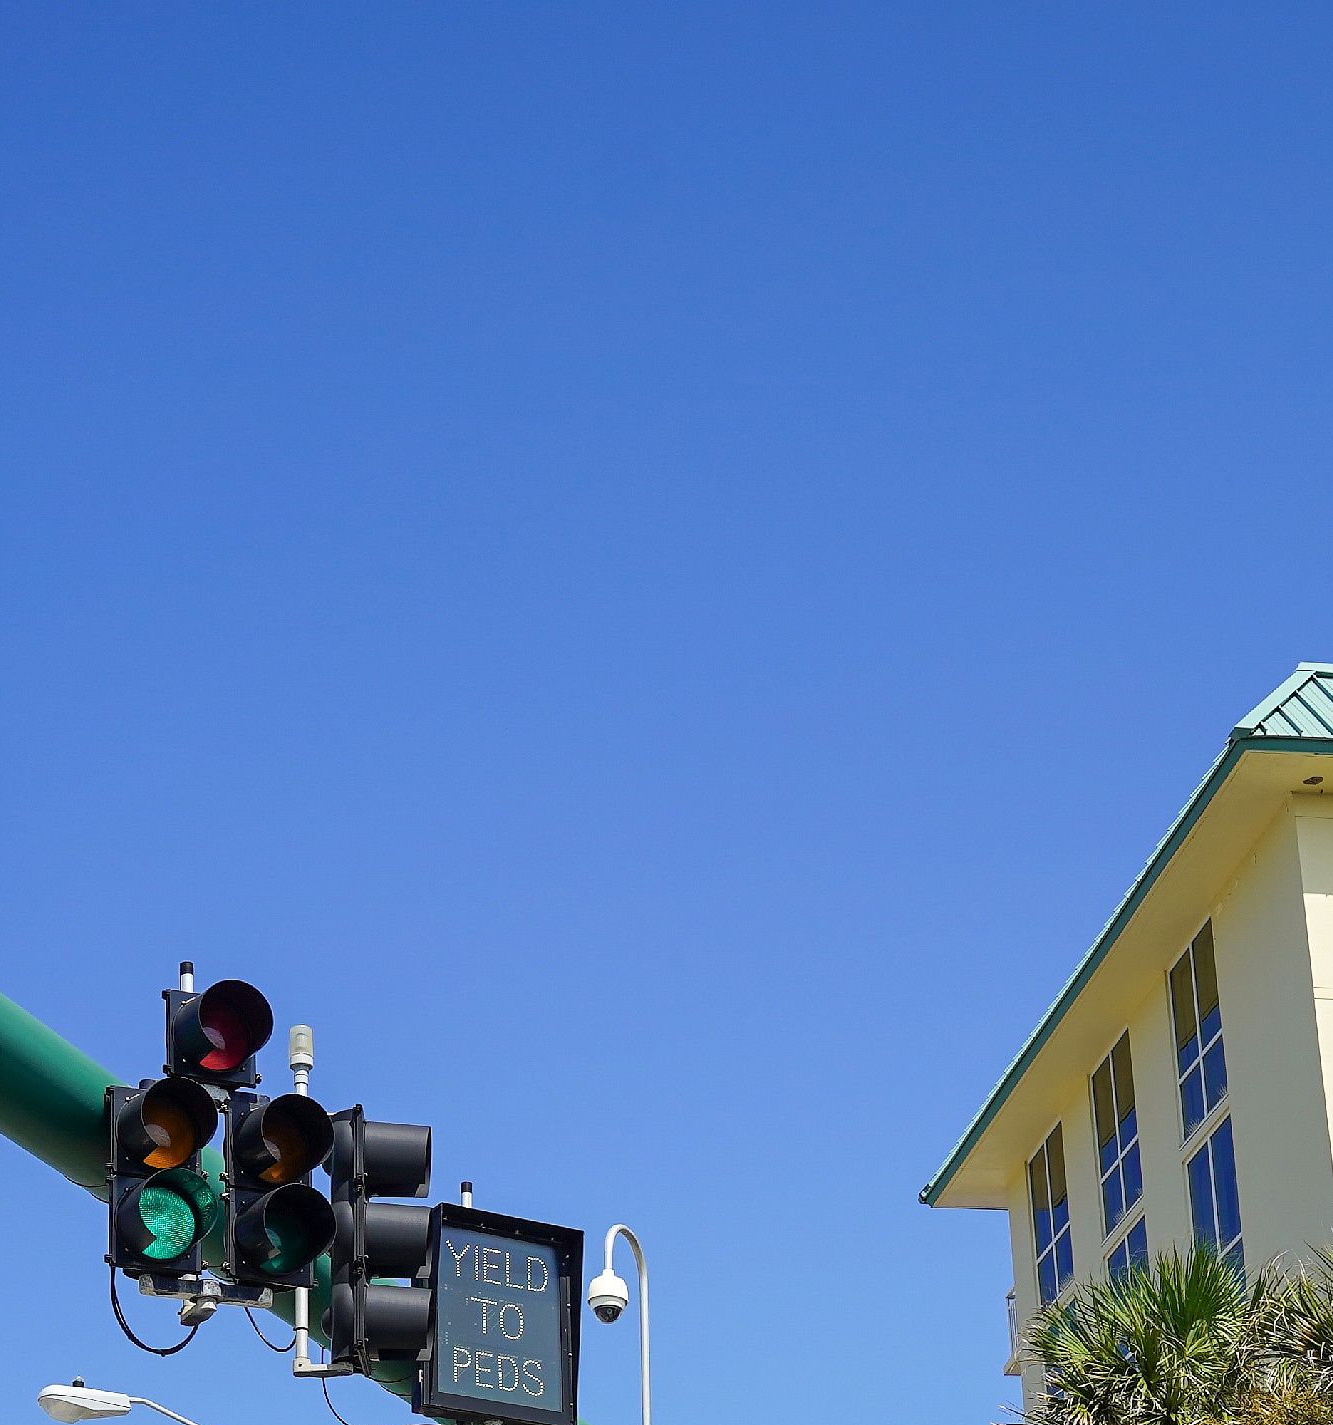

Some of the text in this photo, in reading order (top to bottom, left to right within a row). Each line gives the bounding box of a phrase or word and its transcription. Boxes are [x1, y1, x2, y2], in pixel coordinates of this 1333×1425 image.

[445, 1239, 549, 1292] YIELD
[470, 1296, 524, 1340] TO
[453, 1346, 545, 1397] PEDS
